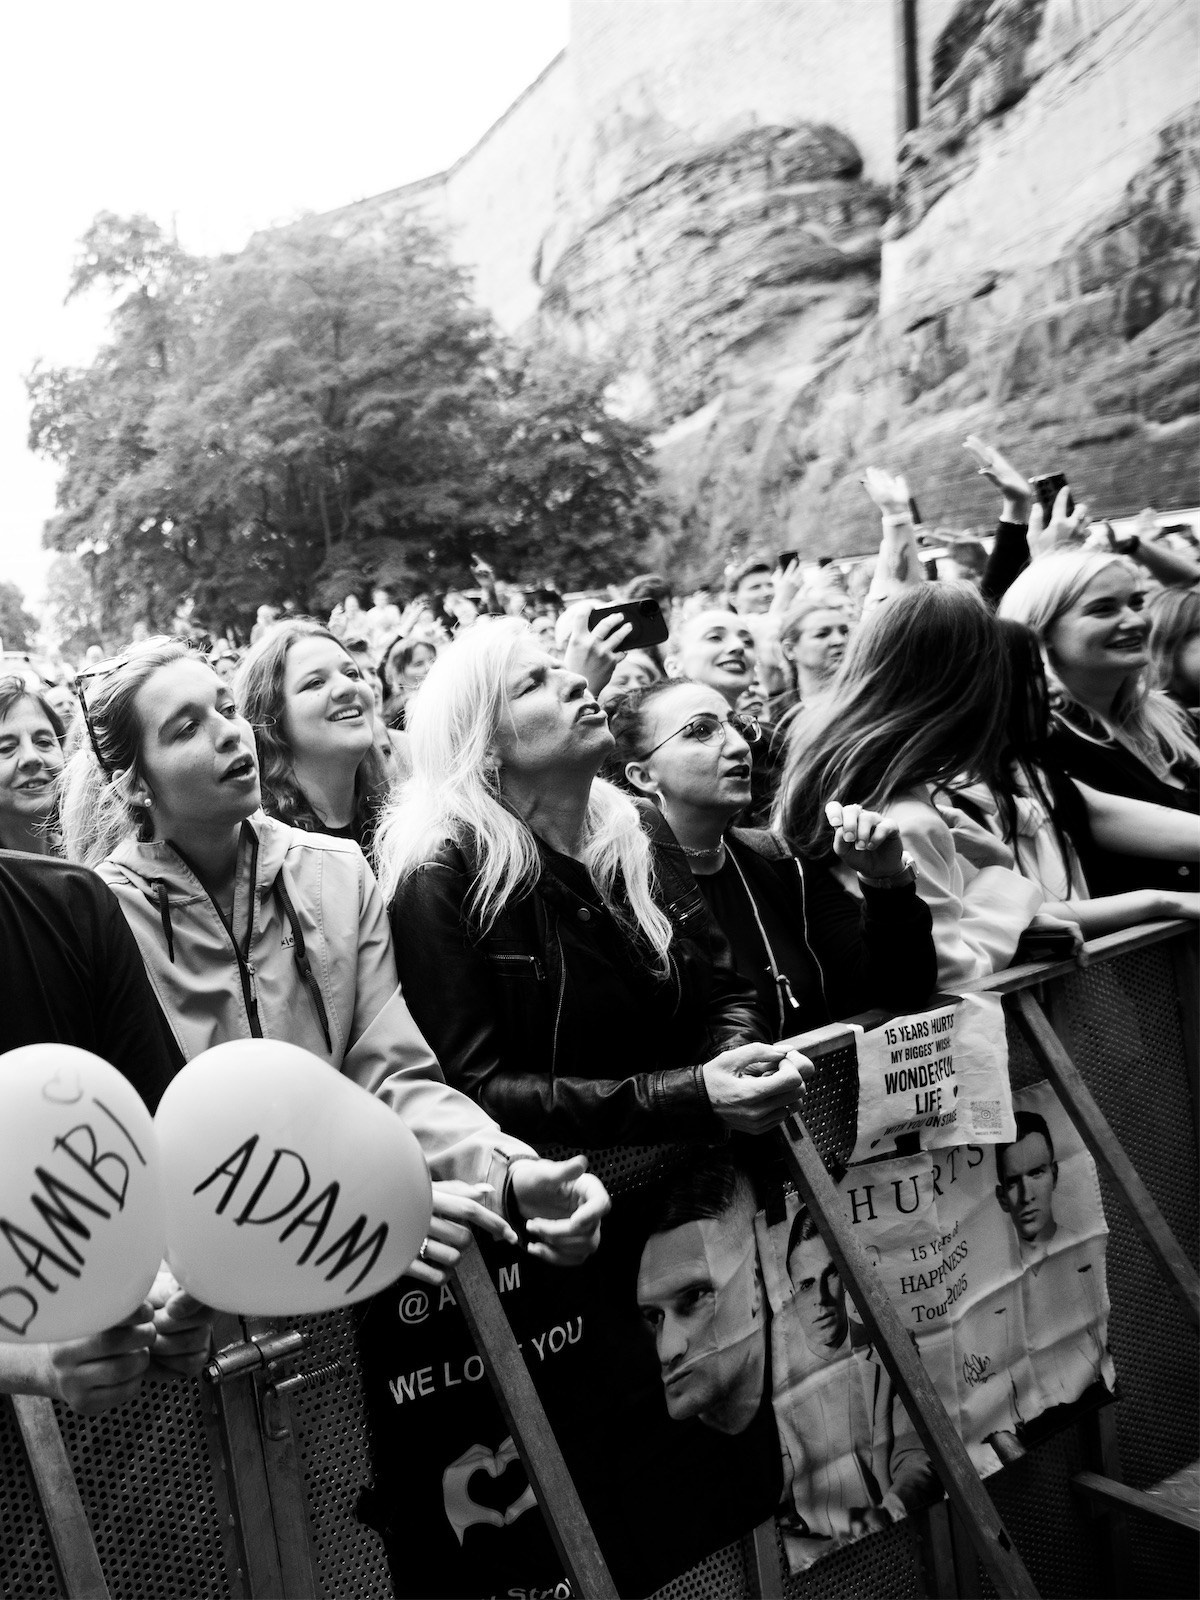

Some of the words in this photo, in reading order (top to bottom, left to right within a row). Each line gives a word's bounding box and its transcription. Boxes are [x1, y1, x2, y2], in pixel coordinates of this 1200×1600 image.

[885, 1028, 897, 1045] 15
[898, 1021, 929, 1042] YEARS
[931, 1013, 954, 1034] HURTS
[891, 1049, 903, 1064] MY
[915, 1087, 942, 1115] LIFE
[907, 1118, 927, 1130] YOU
[925, 1115, 941, 1128] ON
[847, 1143, 984, 1225] HURTS
[193, 1133, 389, 1293] ADAM
[900, 1240, 968, 1295] HAPPNESS
[910, 1245, 927, 1262] 15
[911, 1301, 948, 1323] Tour
[946, 1273, 968, 1305] 2025
[389, 1366, 435, 1405] WE
[531, 1316, 583, 1361] YOU
